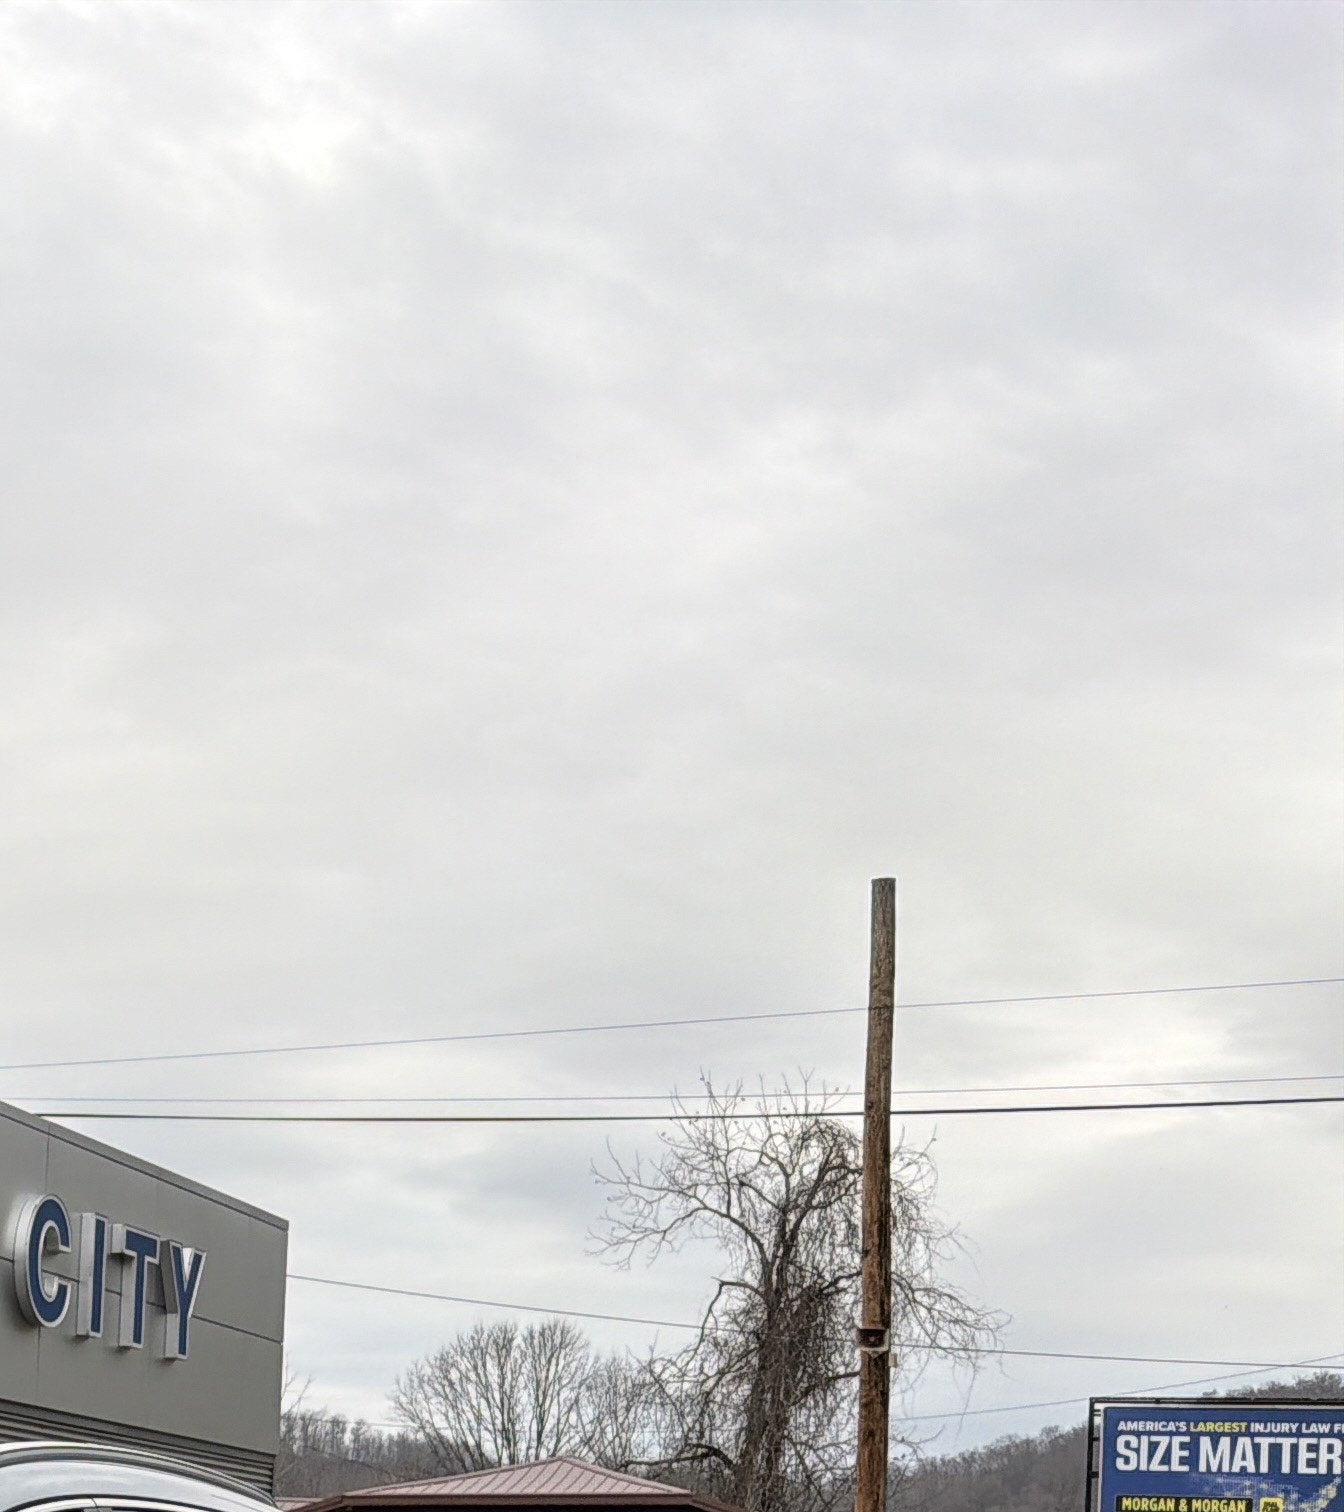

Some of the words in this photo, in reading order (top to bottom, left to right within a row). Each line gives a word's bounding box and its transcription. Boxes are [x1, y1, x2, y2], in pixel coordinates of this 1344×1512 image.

[14, 1194, 207, 1360] CITY
[1117, 1420, 1188, 1432] AMERICA'S
[1189, 1422, 1248, 1433] LARGEST
[1250, 1422, 1299, 1434] INJURY
[1301, 1422, 1332, 1434] LAW
[1115, 1434, 1191, 1472] SIZE
[1198, 1435, 1344, 1475] MATTER
[1121, 1496, 1176, 1512] MORGAN
[1178, 1498, 1188, 1512] &
